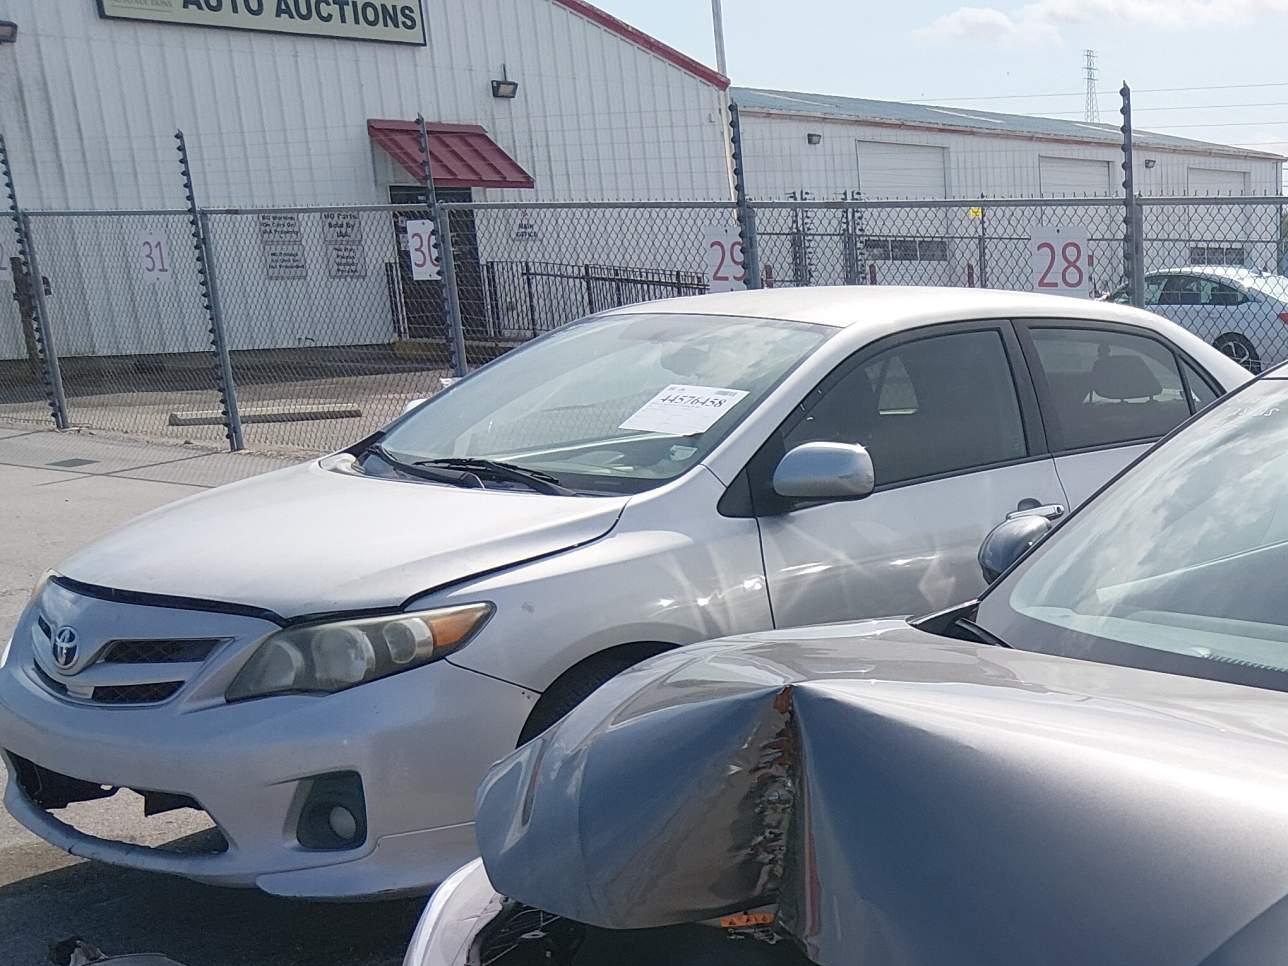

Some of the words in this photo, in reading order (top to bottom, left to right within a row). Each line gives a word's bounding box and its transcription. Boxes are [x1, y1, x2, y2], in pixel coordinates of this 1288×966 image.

[274, 0, 417, 30] AUCTIONS
[142, 241, 168, 273] 31
[710, 240, 747, 281] 29
[1037, 242, 1083, 288] 28
